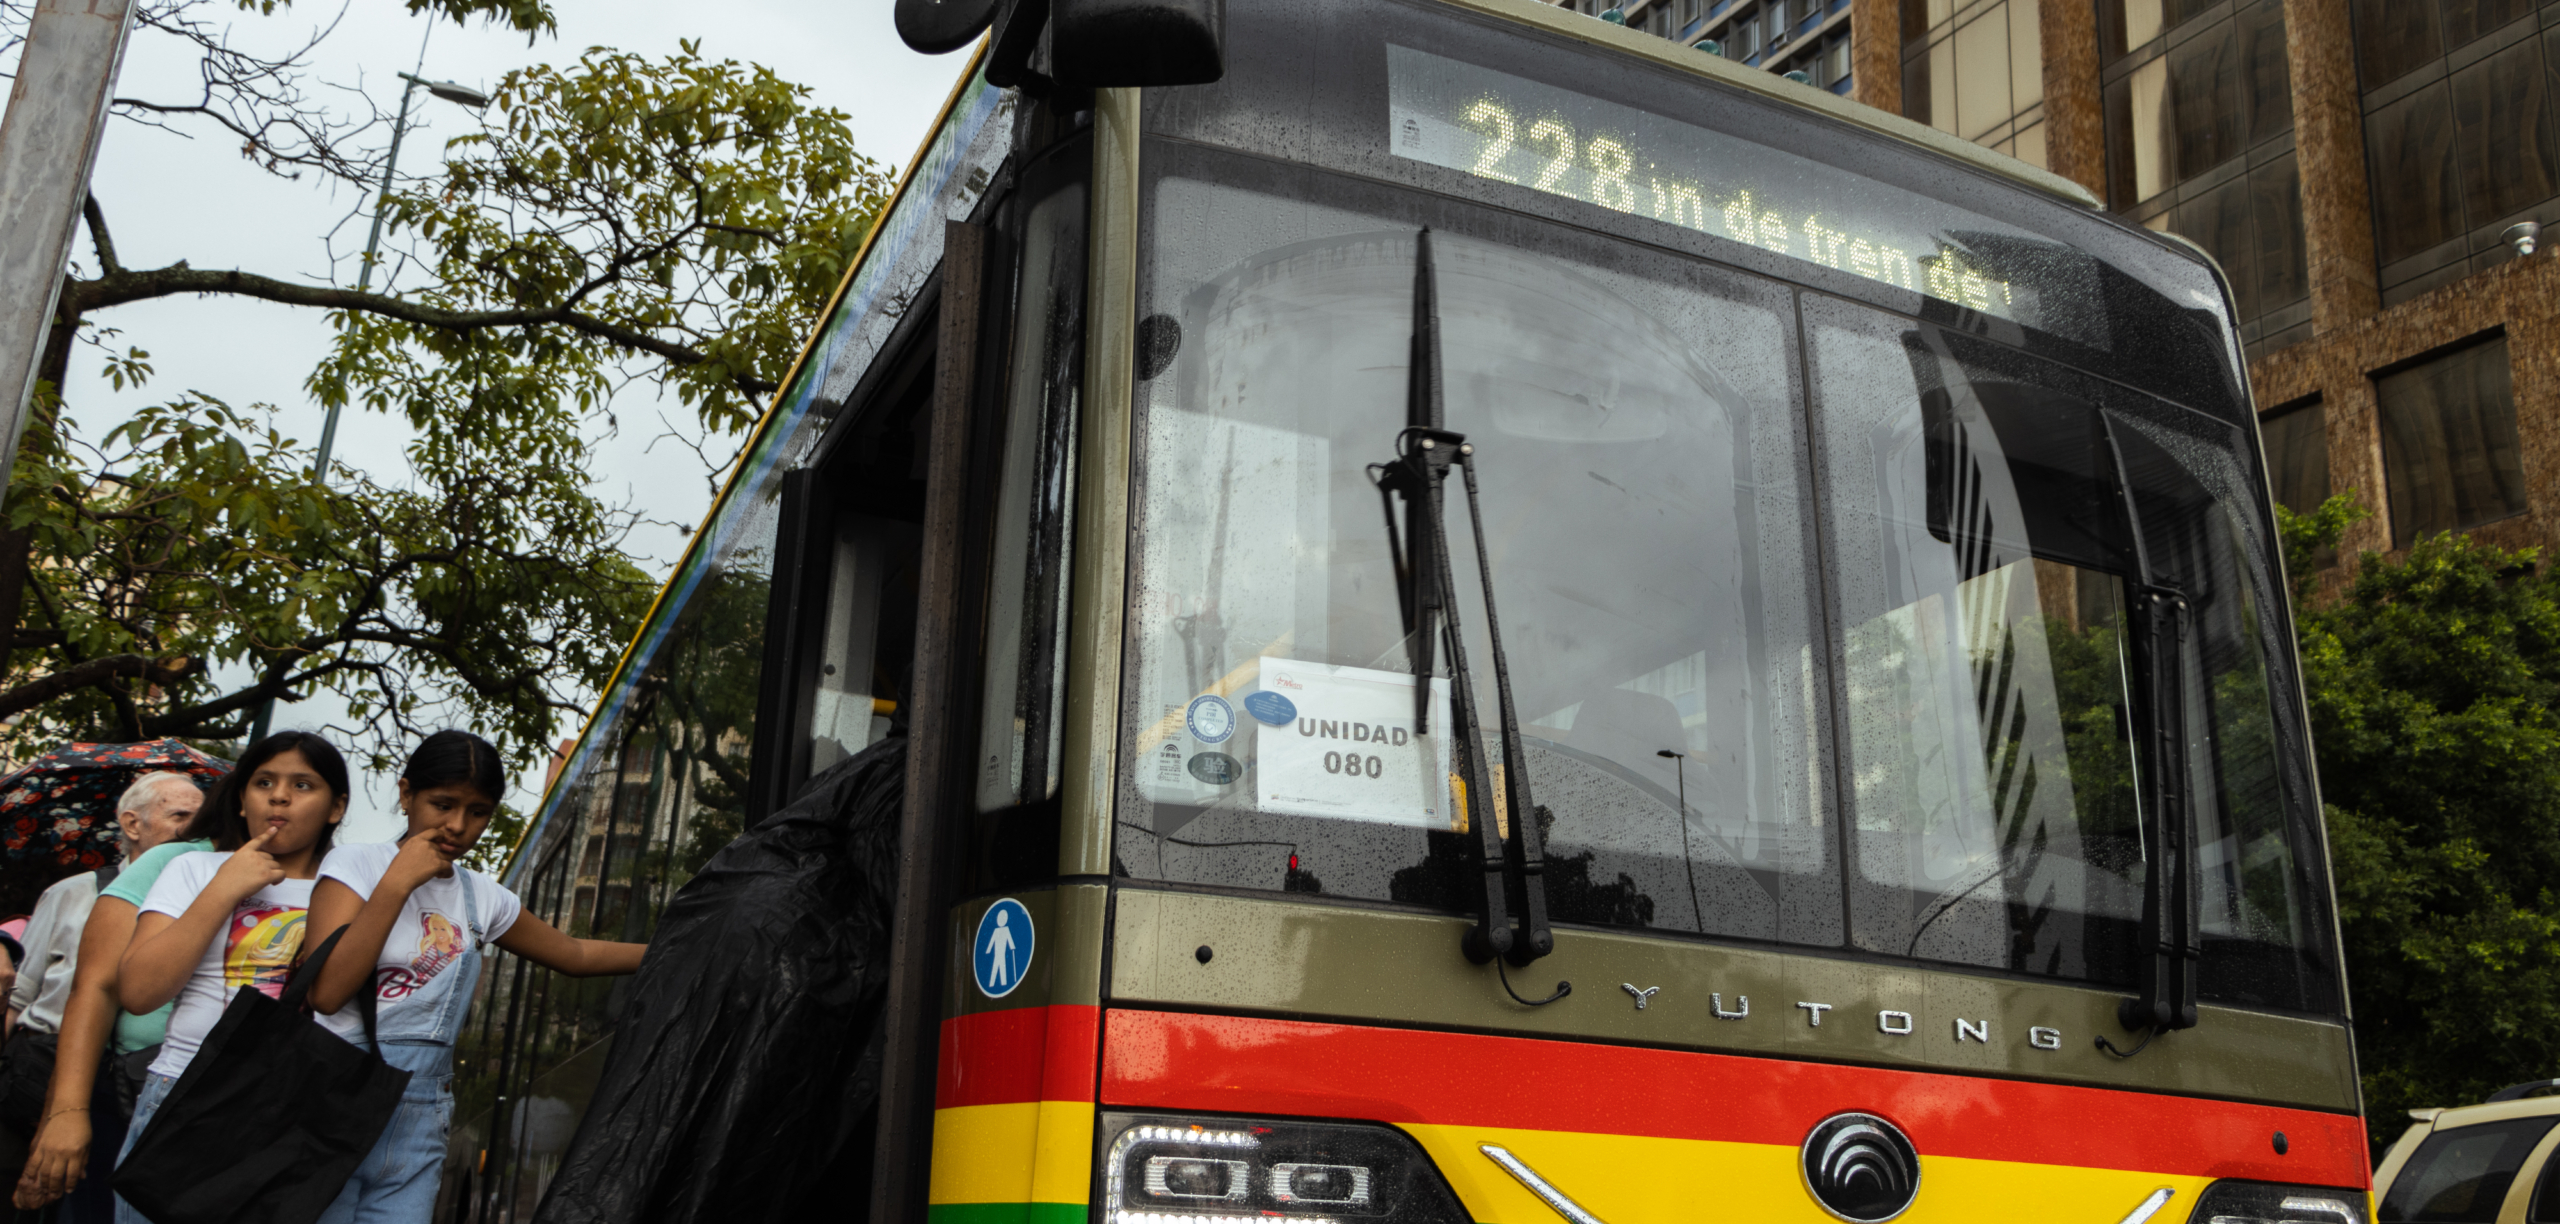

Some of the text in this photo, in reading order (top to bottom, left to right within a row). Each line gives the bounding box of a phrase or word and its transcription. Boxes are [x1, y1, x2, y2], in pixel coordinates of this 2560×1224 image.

[1470, 99, 1635, 215] 228
[1723, 189, 1789, 254] de
[1803, 214, 1912, 290] tren
[1929, 245, 1989, 311] de
[1299, 717, 1408, 747] UNIDAD
[1324, 751, 1383, 780] 080
[1621, 982, 2062, 1050] YUTONG
